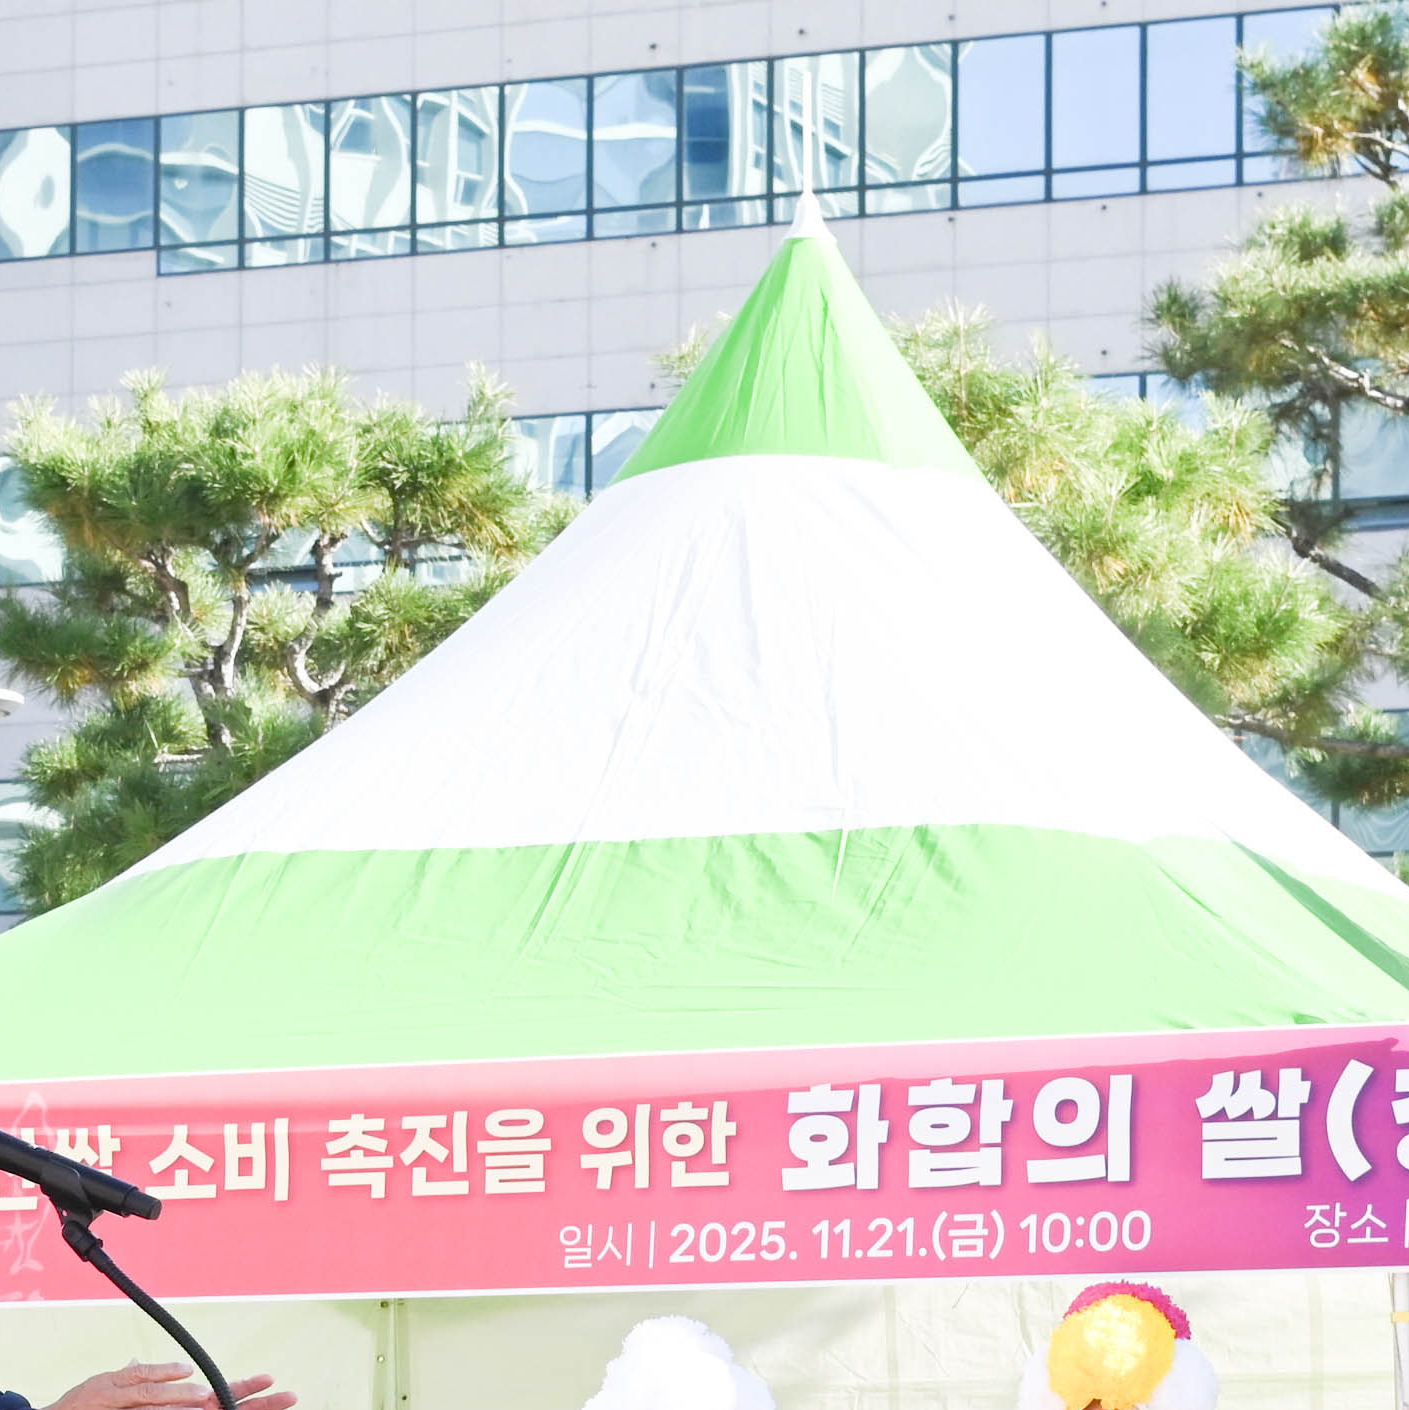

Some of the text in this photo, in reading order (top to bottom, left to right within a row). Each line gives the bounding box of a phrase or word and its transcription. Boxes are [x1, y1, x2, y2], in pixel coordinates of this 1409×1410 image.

[145, 1117, 289, 1200] 소비
[320, 1108, 551, 1198] 촉진을
[580, 1100, 736, 1190] 위한
[780, 1073, 1133, 1191] 화합의
[559, 1209, 1151, 1268] 일시 2025. 11.21.(금) 10:00
[1304, 1202, 1389, 1248] 장소
